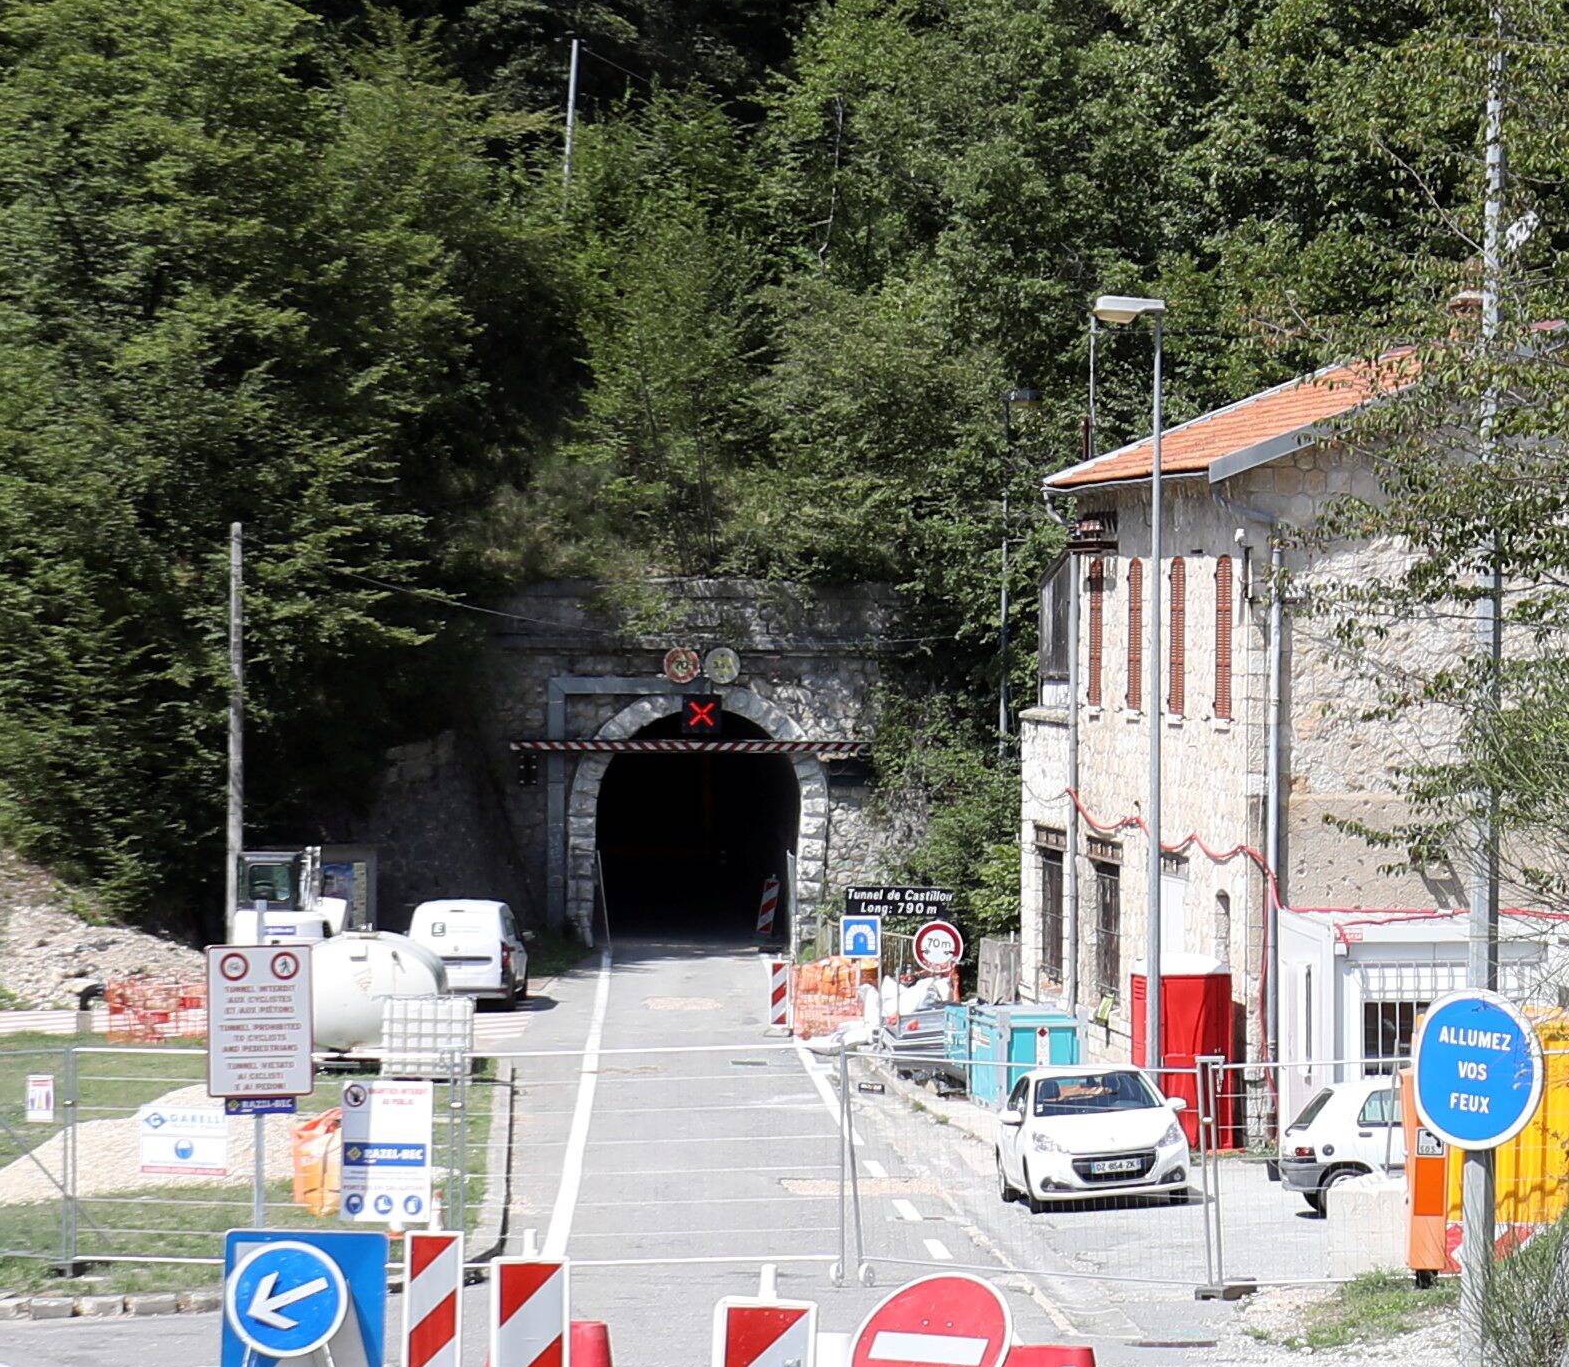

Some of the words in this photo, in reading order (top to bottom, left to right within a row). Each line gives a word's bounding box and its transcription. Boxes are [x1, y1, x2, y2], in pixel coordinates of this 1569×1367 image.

[848, 889, 884, 900] Tunnel
[887, 889, 901, 901] de
[860, 903, 893, 917] Long:
[897, 903, 925, 914] 790
[926, 905, 937, 914] m
[1439, 1025, 1512, 1051] ALLUMEZ
[1457, 1060, 1487, 1081] VOS
[1449, 1092, 1490, 1114] FEUX
[364, 1148, 423, 1160] RAZEL-BEC
